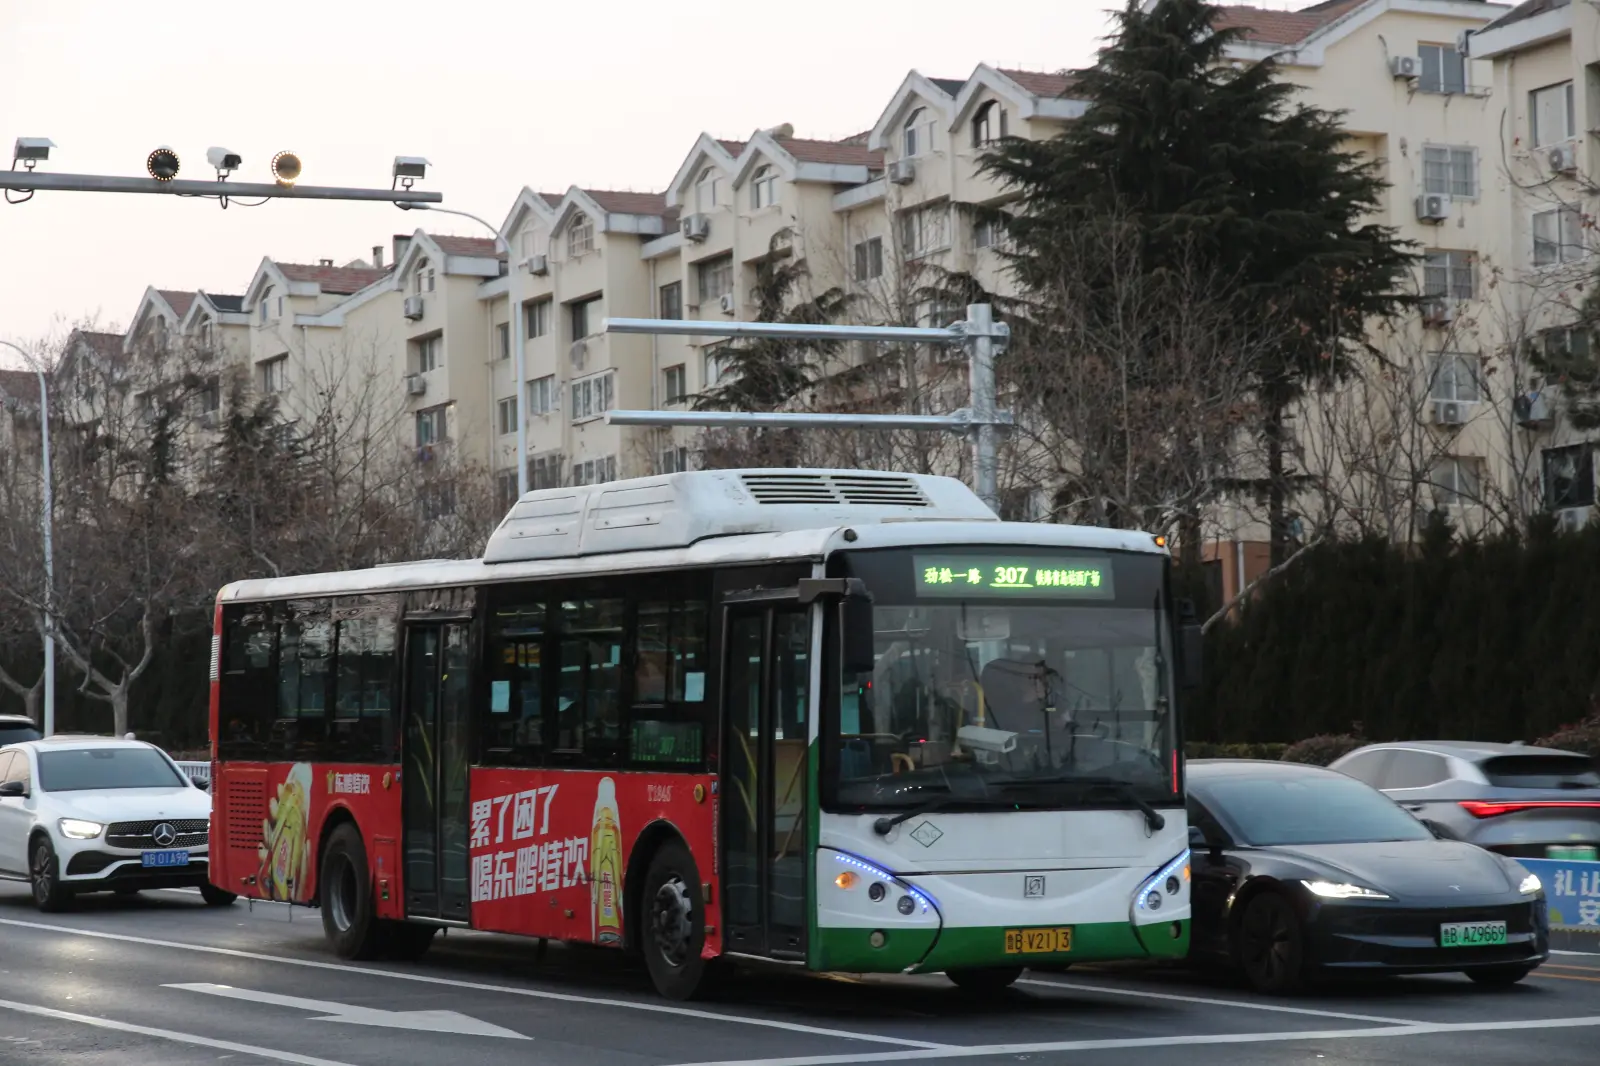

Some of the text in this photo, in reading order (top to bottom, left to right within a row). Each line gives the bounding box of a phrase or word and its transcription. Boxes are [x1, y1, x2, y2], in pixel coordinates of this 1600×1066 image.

[924, 566, 983, 584] 劲松一路
[994, 566, 1029, 584] 307
[470, 784, 559, 848] 累了困了
[471, 836, 588, 903] 喝东鹏特饮
